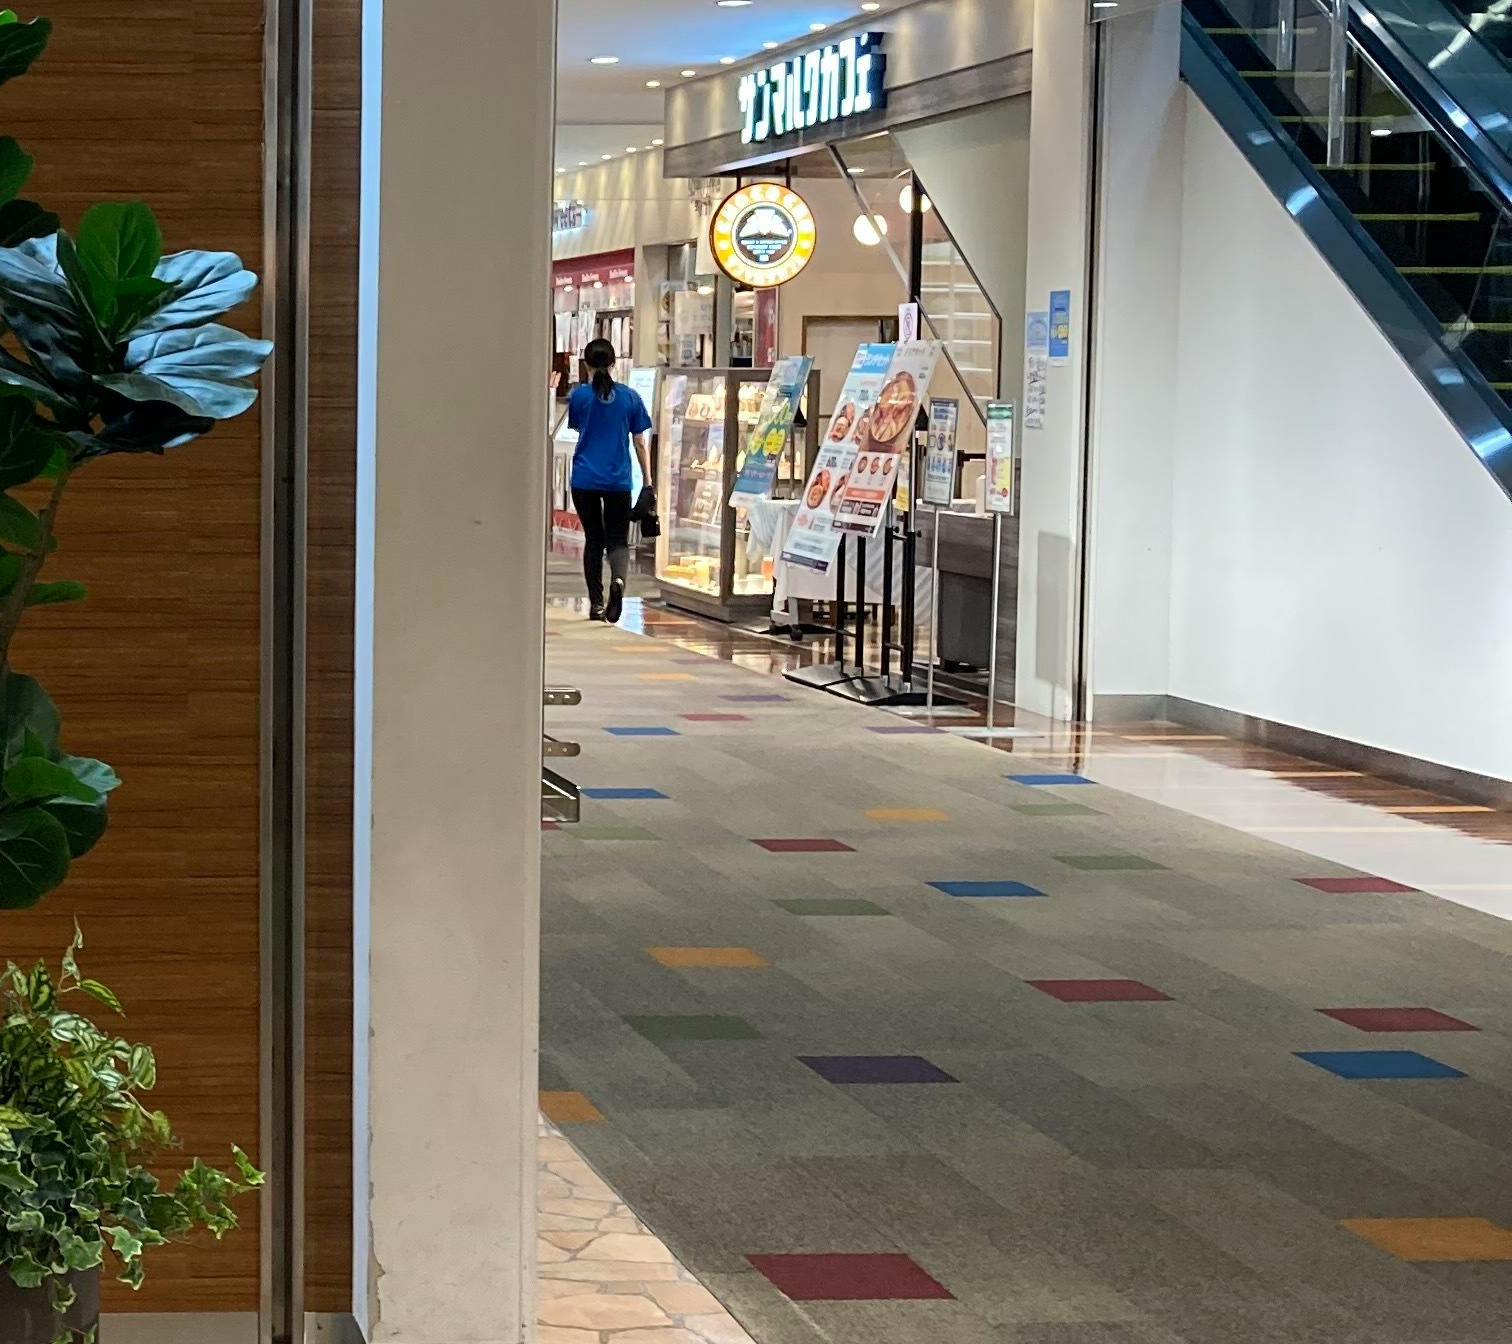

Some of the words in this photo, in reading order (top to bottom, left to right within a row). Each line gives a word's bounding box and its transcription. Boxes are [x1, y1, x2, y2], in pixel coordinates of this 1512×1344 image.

[739, 32, 876, 144] サンマルクカフェ
